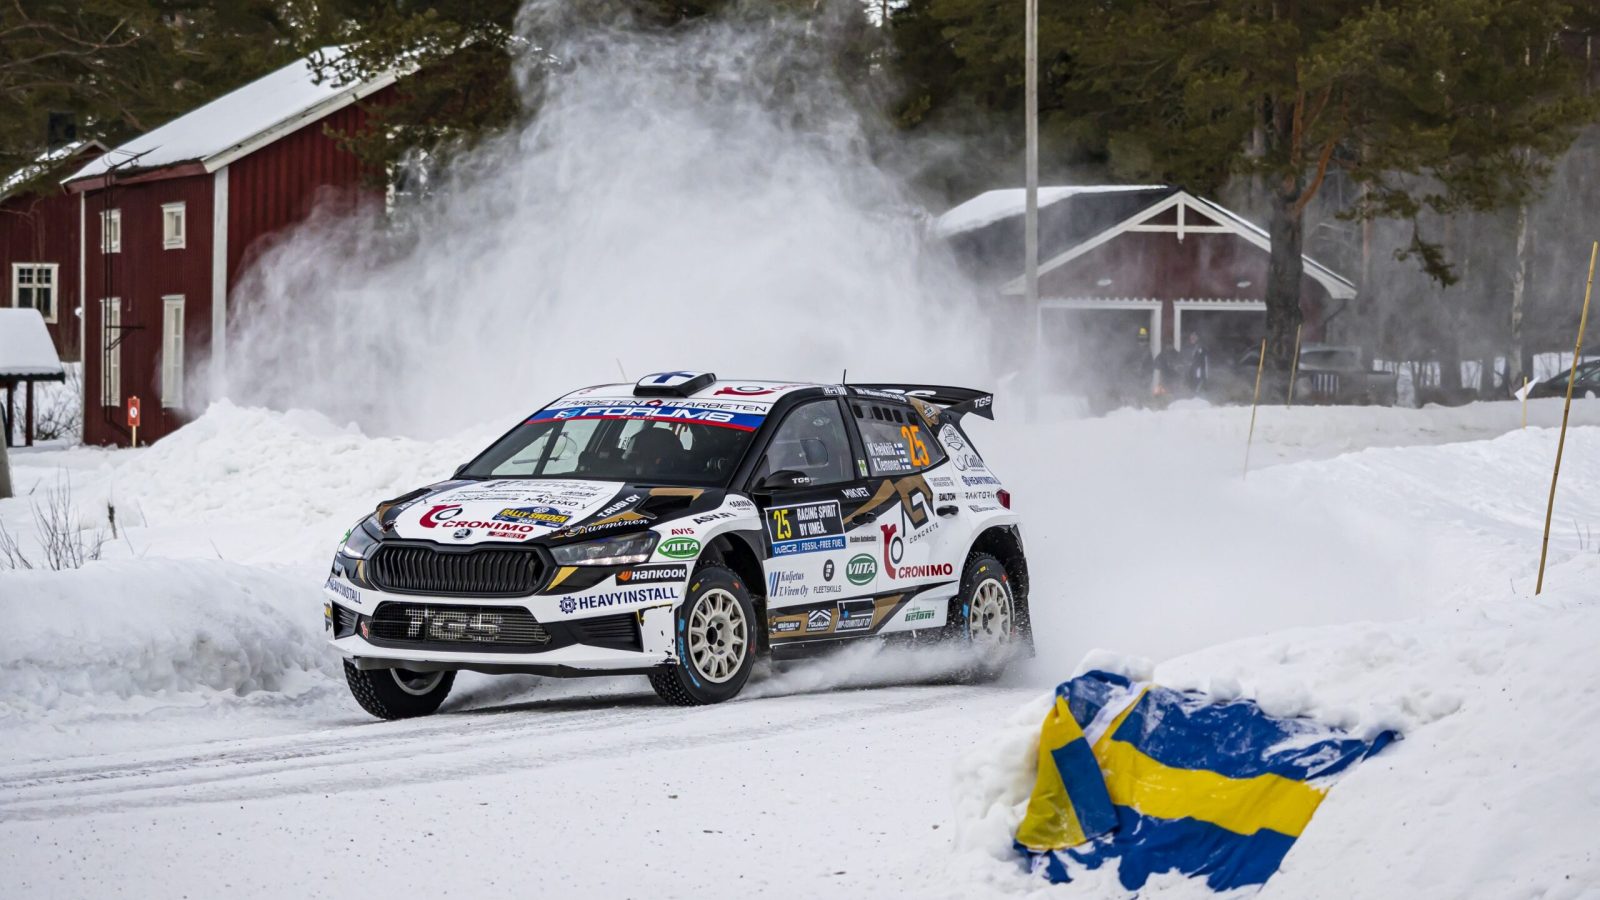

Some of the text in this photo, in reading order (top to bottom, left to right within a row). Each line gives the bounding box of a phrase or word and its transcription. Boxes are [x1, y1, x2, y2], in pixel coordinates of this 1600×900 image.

[682, 401, 767, 412] ARBETEN
[974, 396, 992, 408] TGS
[580, 407, 735, 422] FORUM8
[901, 425, 930, 467] 25
[626, 494, 641, 503] OY
[501, 508, 571, 523] RALLY SWEDEN
[797, 504, 836, 521] RACING SPIRIT
[442, 520, 534, 533] CRONIMO
[773, 509, 792, 539] 25
[799, 523, 808, 536] BY
[909, 522, 939, 544] CONCRETE
[660, 542, 699, 553] VIITA
[801, 540, 831, 551] FOSSIL-FREE
[832, 539, 844, 548] FUEL
[848, 561, 876, 575] VIITA
[899, 563, 953, 579] CRONIMO
[780, 570, 804, 583] Kuljetus
[800, 585, 809, 597] Oy
[813, 585, 842, 593] FLEETSKILLS
[579, 587, 679, 609] HEAVYINSTALL
[405, 608, 502, 641] TGS
